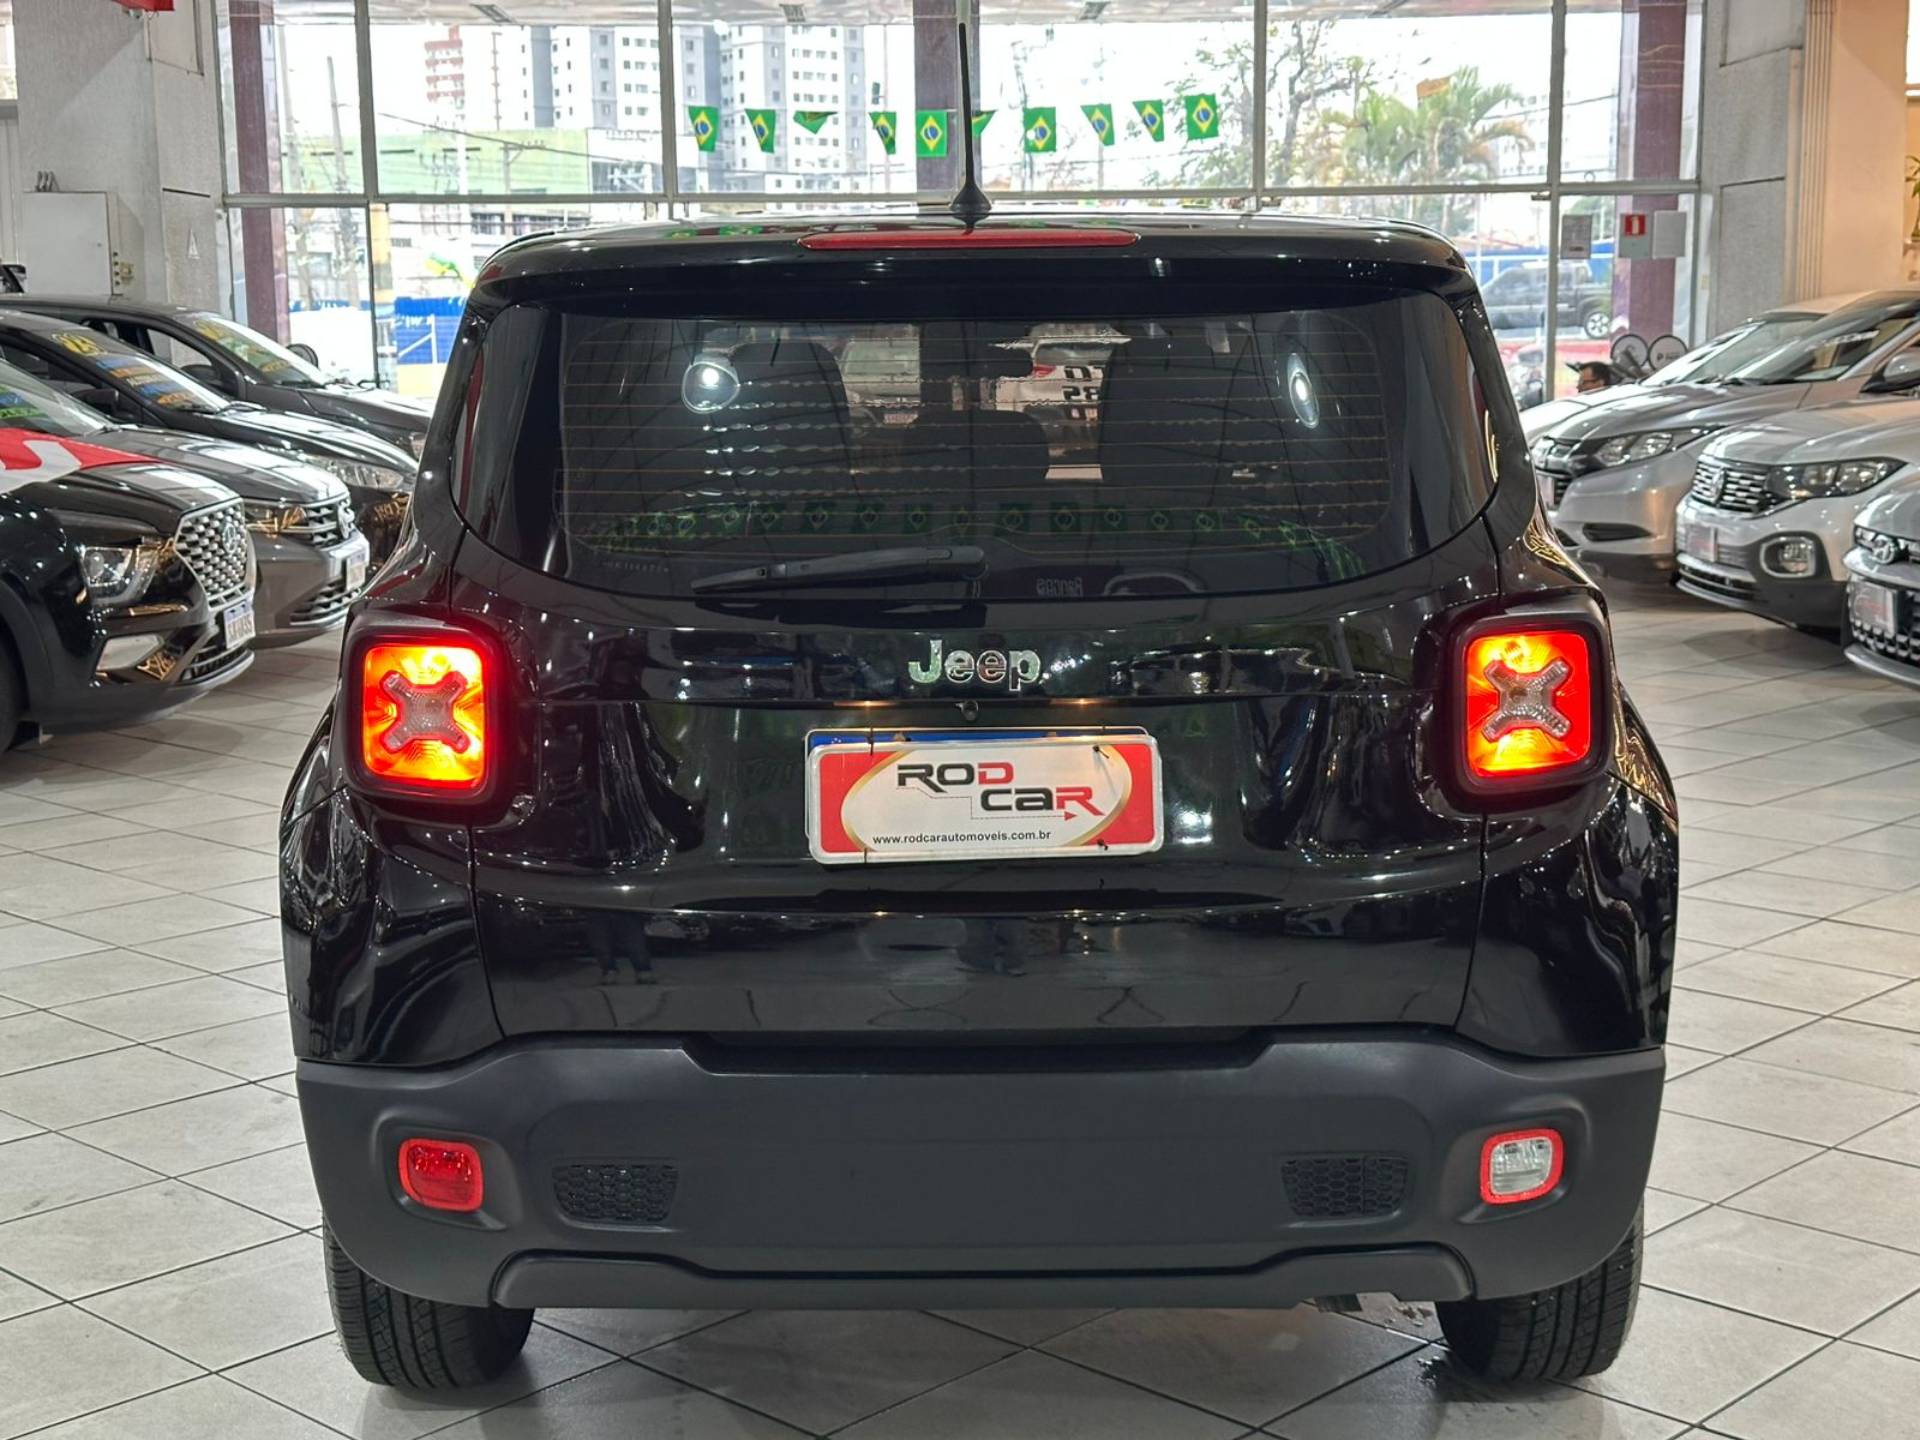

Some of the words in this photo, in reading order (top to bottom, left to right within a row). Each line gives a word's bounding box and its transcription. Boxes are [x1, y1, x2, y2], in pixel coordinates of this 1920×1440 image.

[908, 639, 1042, 691] Jeep
[897, 762, 1014, 792] ROD
[872, 830, 1052, 845] www.rodcarautomoveis.com.br
